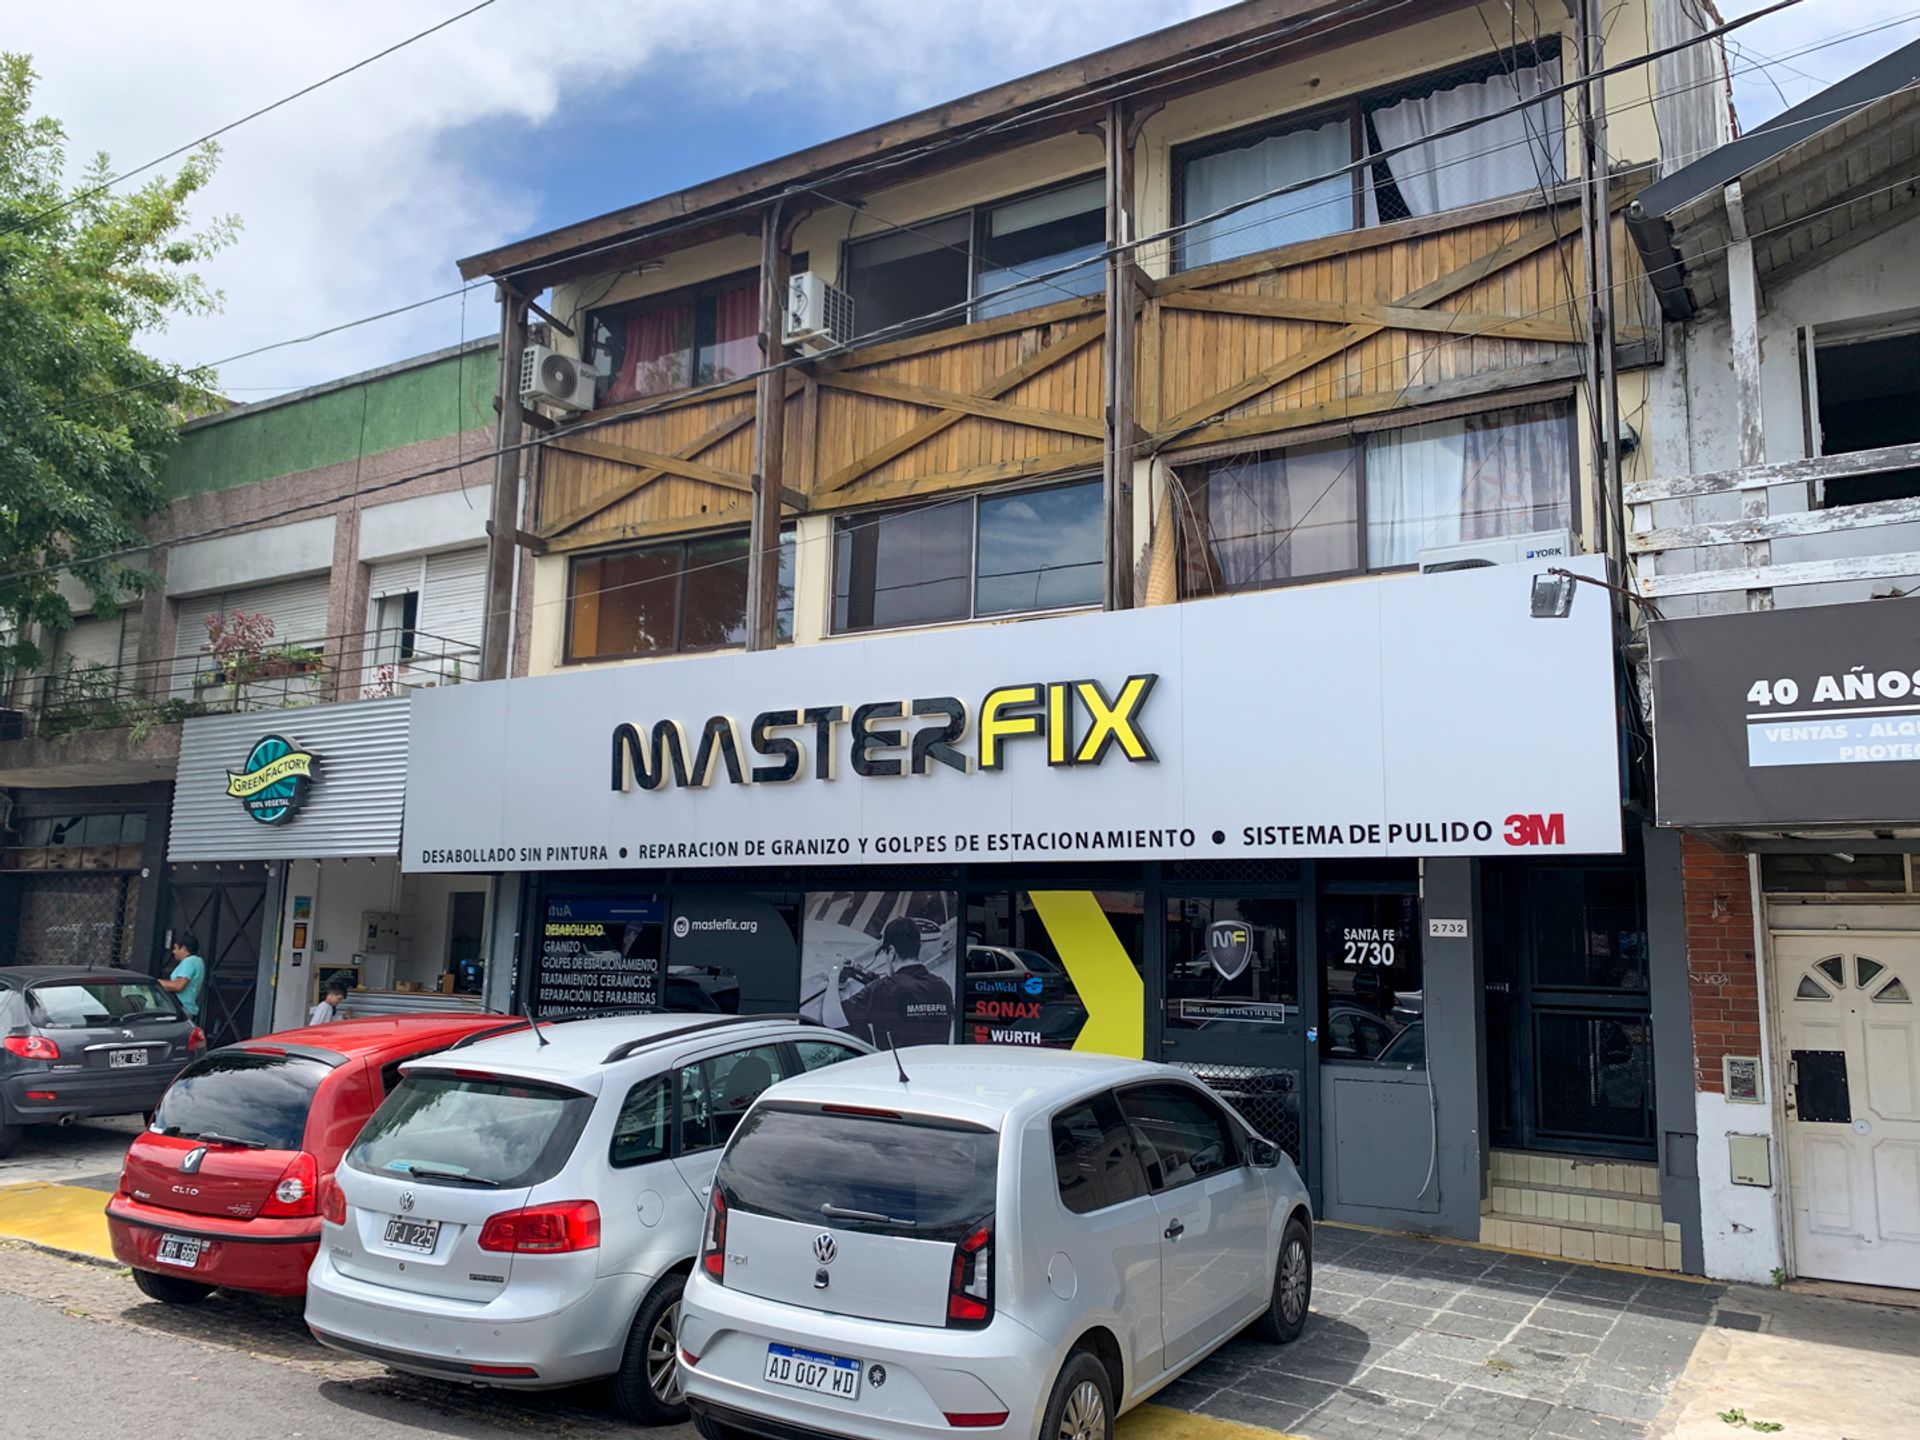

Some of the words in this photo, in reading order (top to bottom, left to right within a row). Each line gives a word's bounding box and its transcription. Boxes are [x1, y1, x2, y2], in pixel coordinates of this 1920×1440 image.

[1536, 547, 1562, 558] YORK
[1747, 678, 1799, 706] 40
[610, 673, 1159, 792] MASTERFIX
[1764, 725, 1848, 742] VENTAS
[422, 848, 516, 863] DESABOLLADO
[520, 847, 542, 862] SIN
[546, 845, 608, 861] PINTURA
[639, 841, 739, 859] REPARACION
[744, 840, 765, 856] DE
[771, 837, 850, 856] GRANIZO
[858, 837, 869, 854] Y
[874, 836, 947, 853] GOLPES
[955, 834, 979, 852] DE
[987, 828, 1196, 851] ESTACIONAMIENTO
[1243, 824, 1344, 846] SISTEMA
[1349, 824, 1381, 844] DE
[1388, 820, 1493, 844] PULIDO
[1503, 813, 1565, 846] 3M
[545, 923, 604, 936] DESABOLLADO
[1343, 927, 1380, 941] SANTA
[1382, 928, 1395, 942] FE
[1431, 923, 1466, 933] 2732
[543, 941, 580, 953] GRANIZO
[1343, 941, 1395, 966] 2730
[542, 956, 571, 969] GOLPES
[572, 958, 583, 970] DE
[583, 958, 658, 972] ESTACIONAMIENTO
[541, 972, 598, 986] TRATAMIENTOS
[600, 972, 651, 988] CERÁMICOS
[540, 986, 592, 1001] REPARACIÓN
[593, 990, 604, 1003] DE
[605, 991, 656, 1005] PARABRISAS
[975, 1001, 1040, 1018] SONAX
[991, 1029, 1041, 1045] WÜRTH
[171, 1185, 199, 1196] CLIO
[411, 1226, 436, 1247] 225
[769, 1357, 792, 1381] AD
[795, 1362, 828, 1388] 007
[832, 1369, 854, 1394] WD
